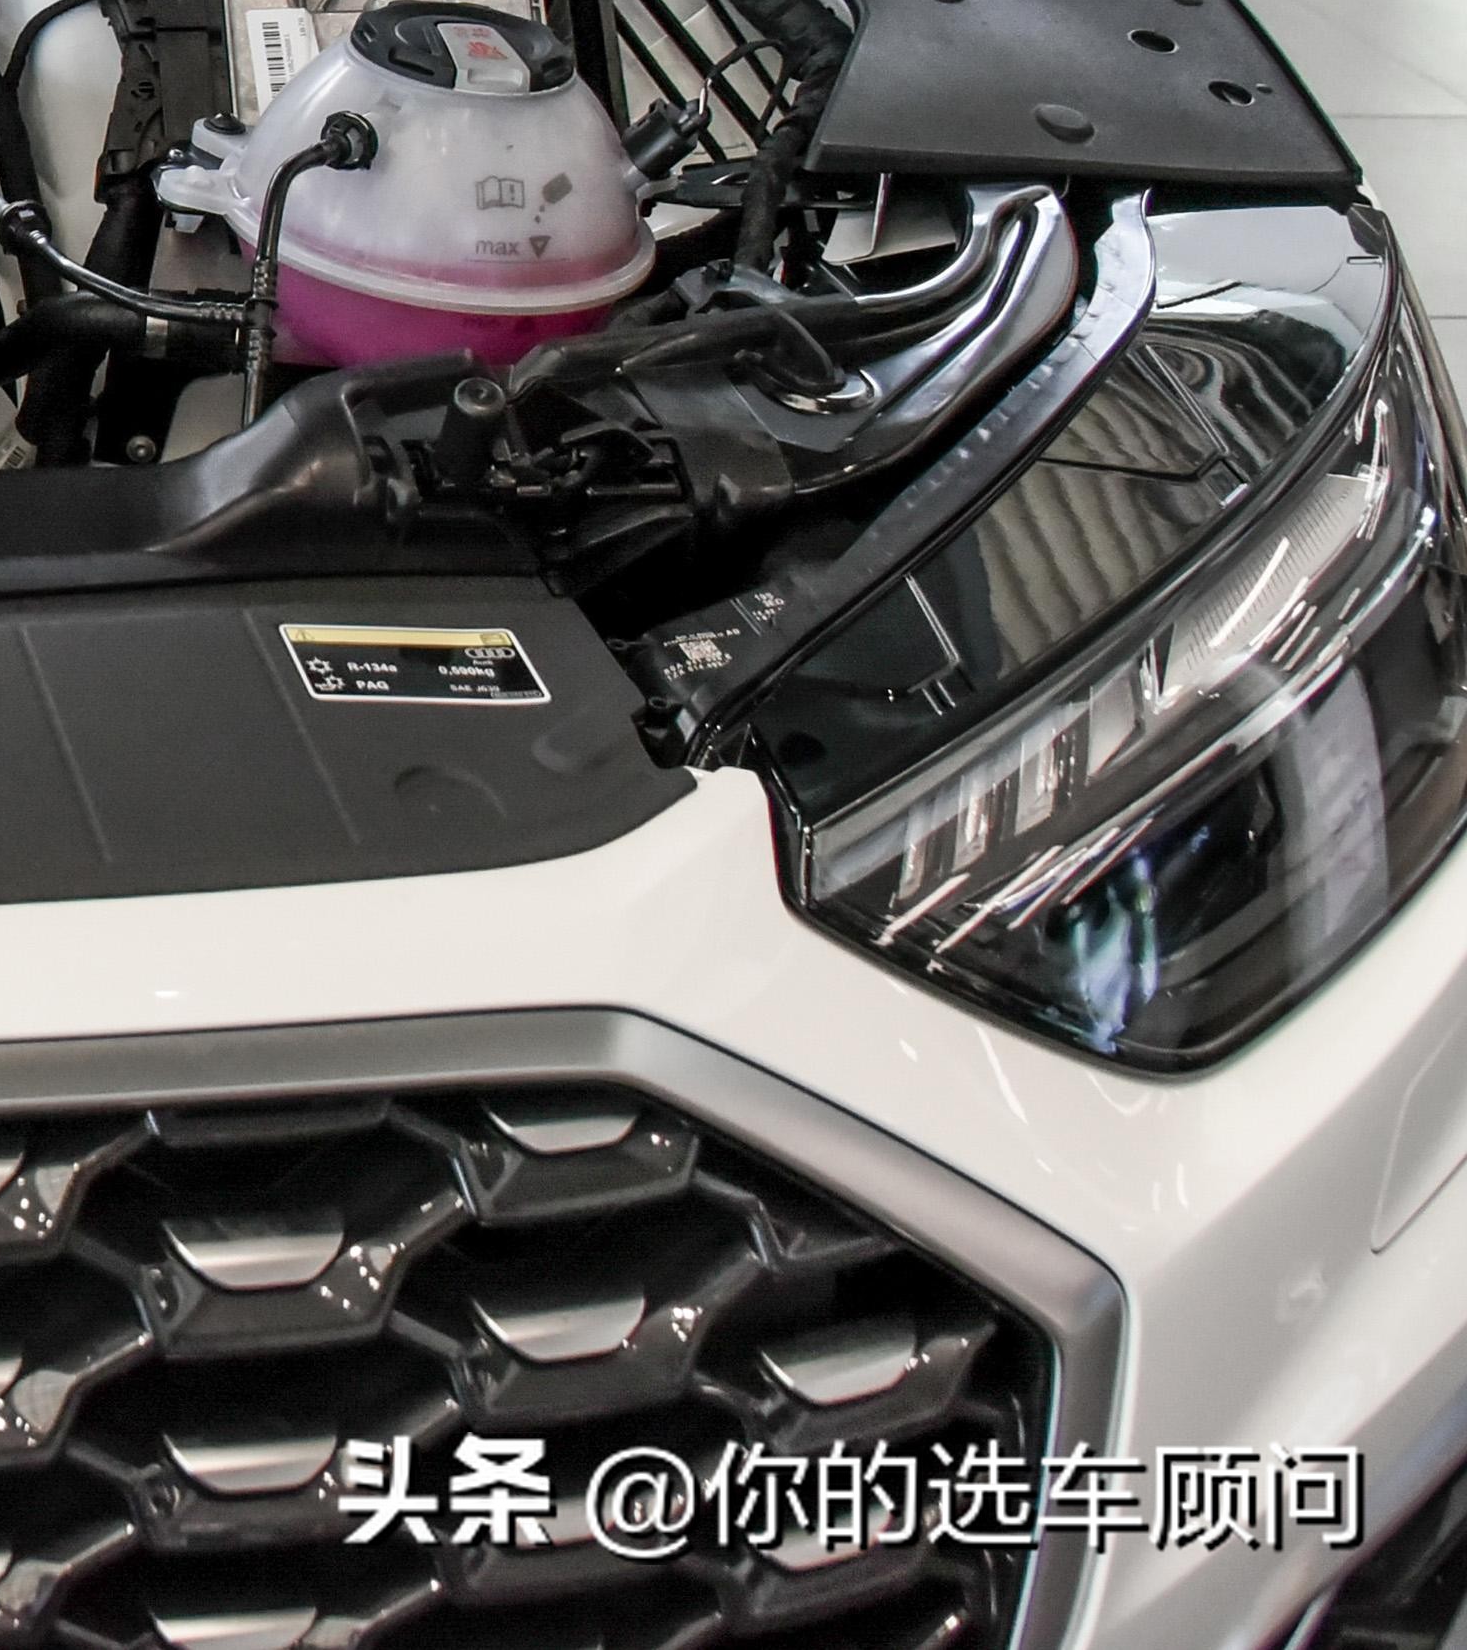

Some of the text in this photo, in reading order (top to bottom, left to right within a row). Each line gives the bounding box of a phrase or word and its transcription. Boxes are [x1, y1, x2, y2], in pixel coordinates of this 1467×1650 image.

[475, 239, 520, 255] max
[346, 661, 398, 673] R-134a
[355, 679, 390, 691] PAG
